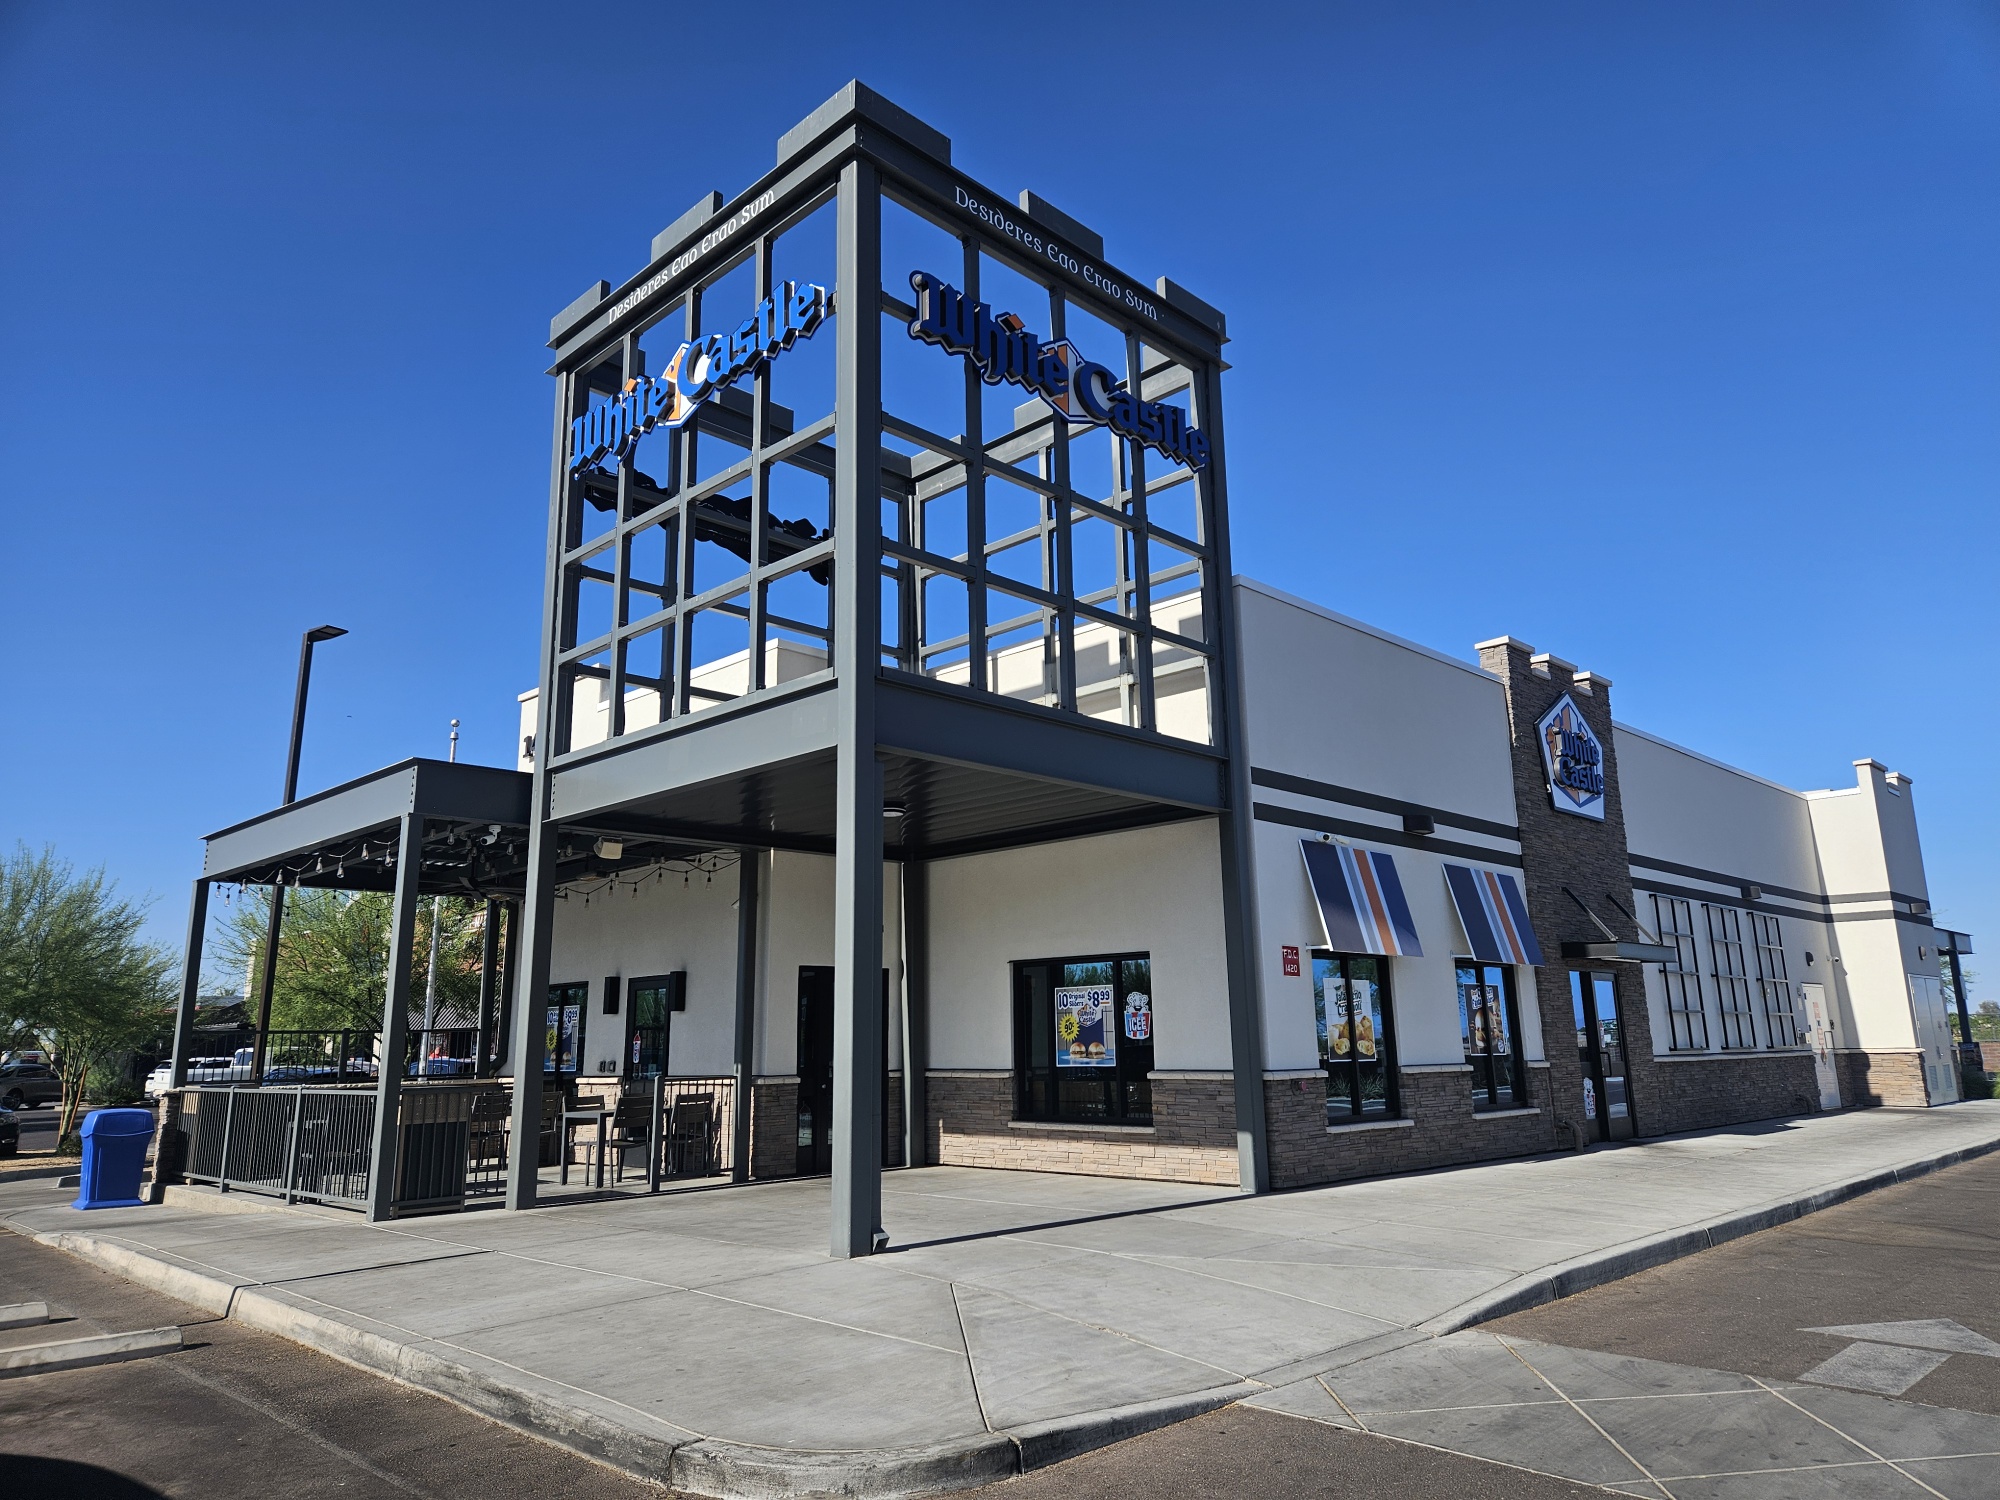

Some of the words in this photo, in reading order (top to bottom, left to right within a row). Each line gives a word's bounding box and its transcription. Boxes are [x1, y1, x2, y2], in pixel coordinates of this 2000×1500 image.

[954, 185, 1043, 253] Desideres
[608, 269, 669, 325] Desideres
[569, 375, 674, 477] White
[677, 280, 827, 399] Castle
[911, 272, 1069, 398] White
[1074, 361, 1211, 468] Castle
[1554, 727, 1601, 766] White
[1555, 756, 1604, 796] Castle
[1285, 964, 1298, 973] 1420
[1058, 992, 1069, 1008] 10
[1128, 1016, 1147, 1032] ICEE
